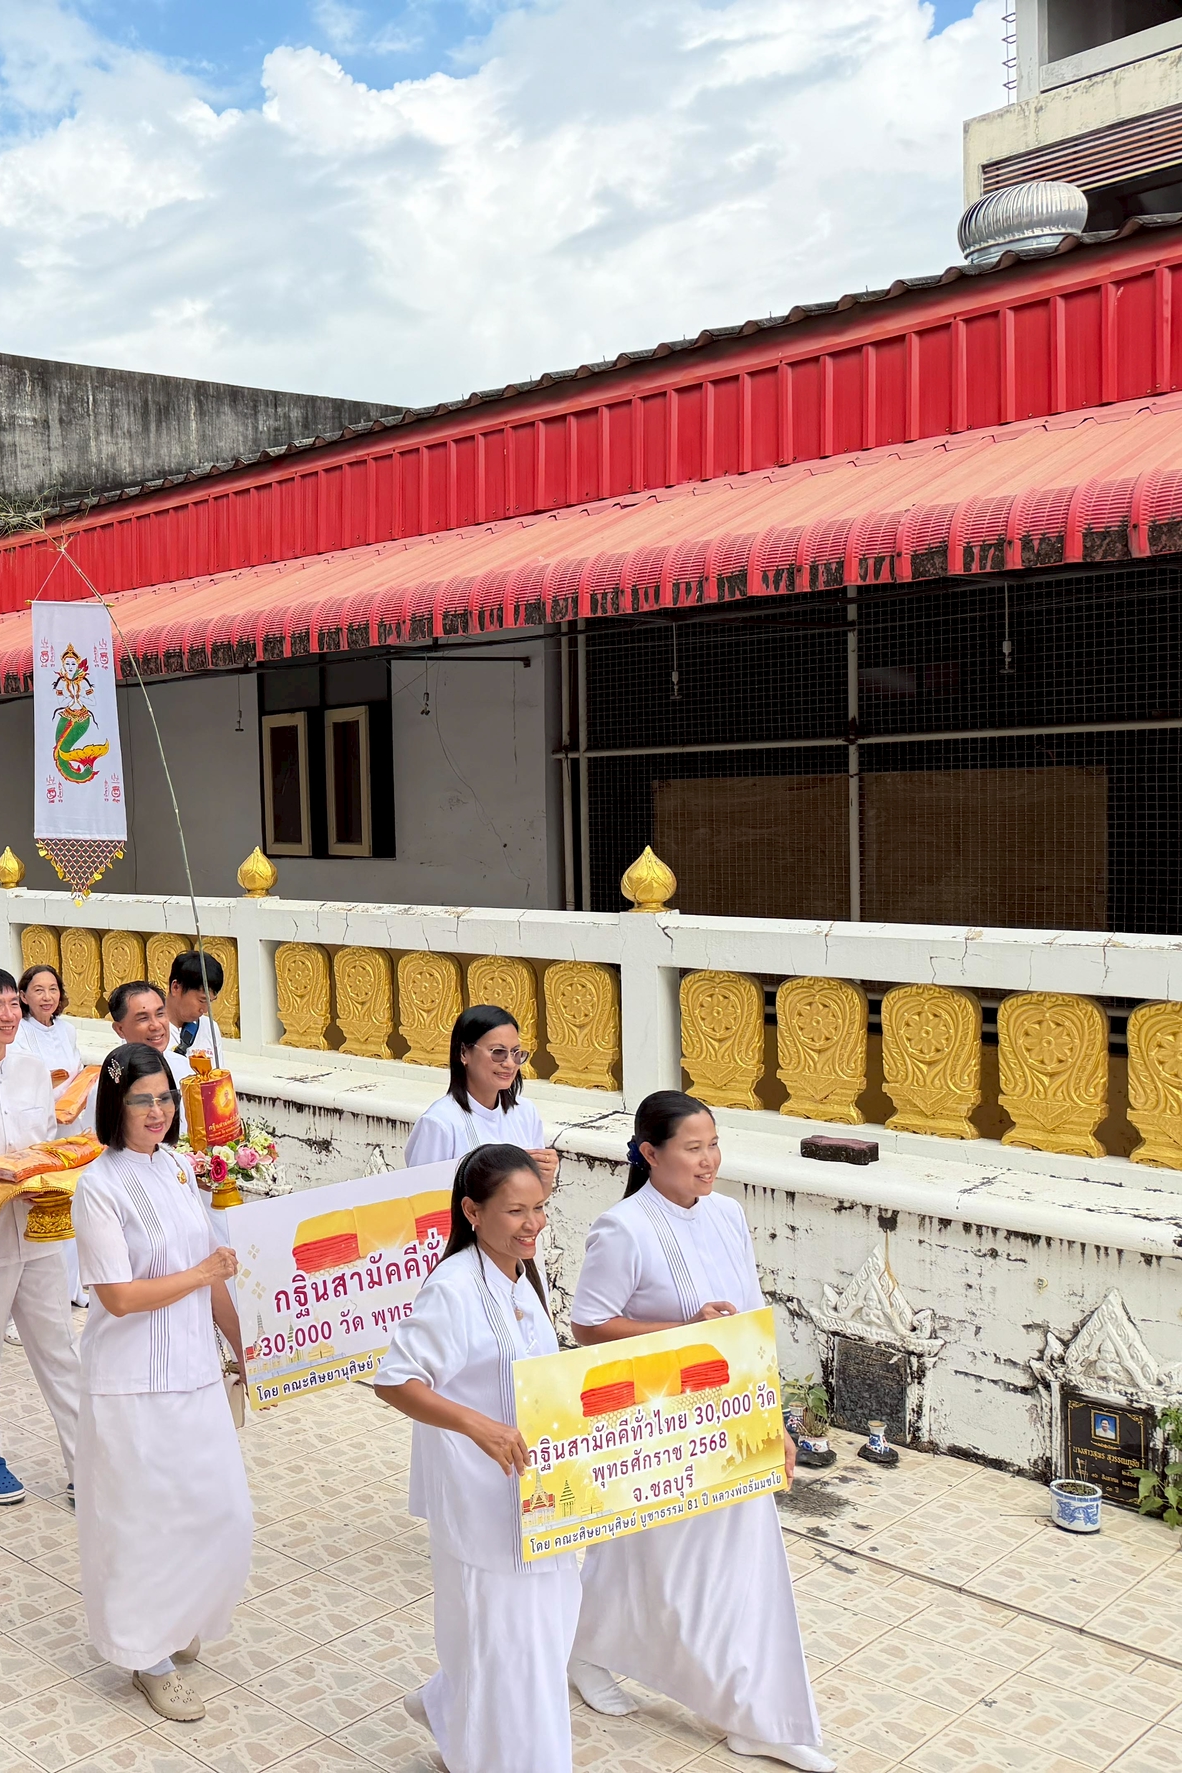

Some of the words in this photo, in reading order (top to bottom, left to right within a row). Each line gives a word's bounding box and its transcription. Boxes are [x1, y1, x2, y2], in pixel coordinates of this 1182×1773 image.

[262, 1321, 332, 1356] 30,000
[340, 1309, 364, 1334] วัด
[257, 1385, 278, 1401] โดย
[283, 1355, 373, 1394] คณะศิษยานุศิษย์
[529, 1409, 687, 1472] กฐินสามัคคีทั่วไทย
[695, 1394, 751, 1425] 30,000
[756, 1383, 776, 1408] วัด
[593, 1445, 682, 1488] พุทธศักราช
[689, 1431, 727, 1457] 2568
[633, 1464, 694, 1502] จ.ชลบุรี
[530, 1538, 550, 1553] โดย
[555, 1512, 636, 1547] คณะศิษยานุศิษย์
[640, 1503, 684, 1528] บูชาธรรม
[687, 1498, 698, 1510] 81
[701, 1492, 709, 1506] ปี
